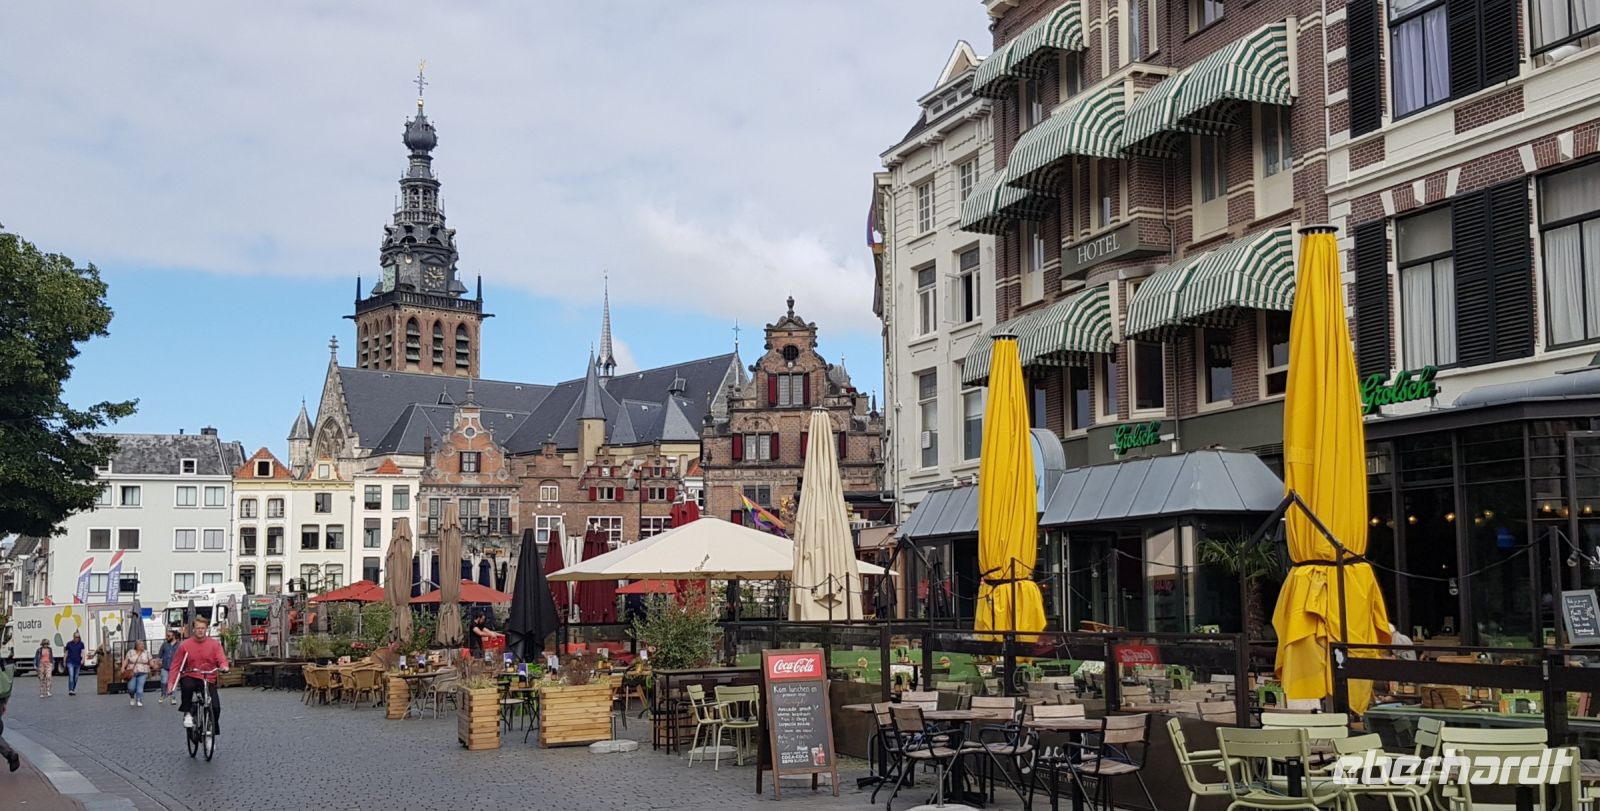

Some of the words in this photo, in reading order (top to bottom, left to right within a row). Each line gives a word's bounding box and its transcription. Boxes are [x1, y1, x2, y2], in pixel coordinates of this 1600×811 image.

[1077, 233, 1120, 264] HOTEL
[1360, 365, 1432, 415] Grolsch
[1114, 420, 1157, 455] Grolsch
[17, 619, 42, 632] quatra
[774, 658, 815, 673] Coca-Cola
